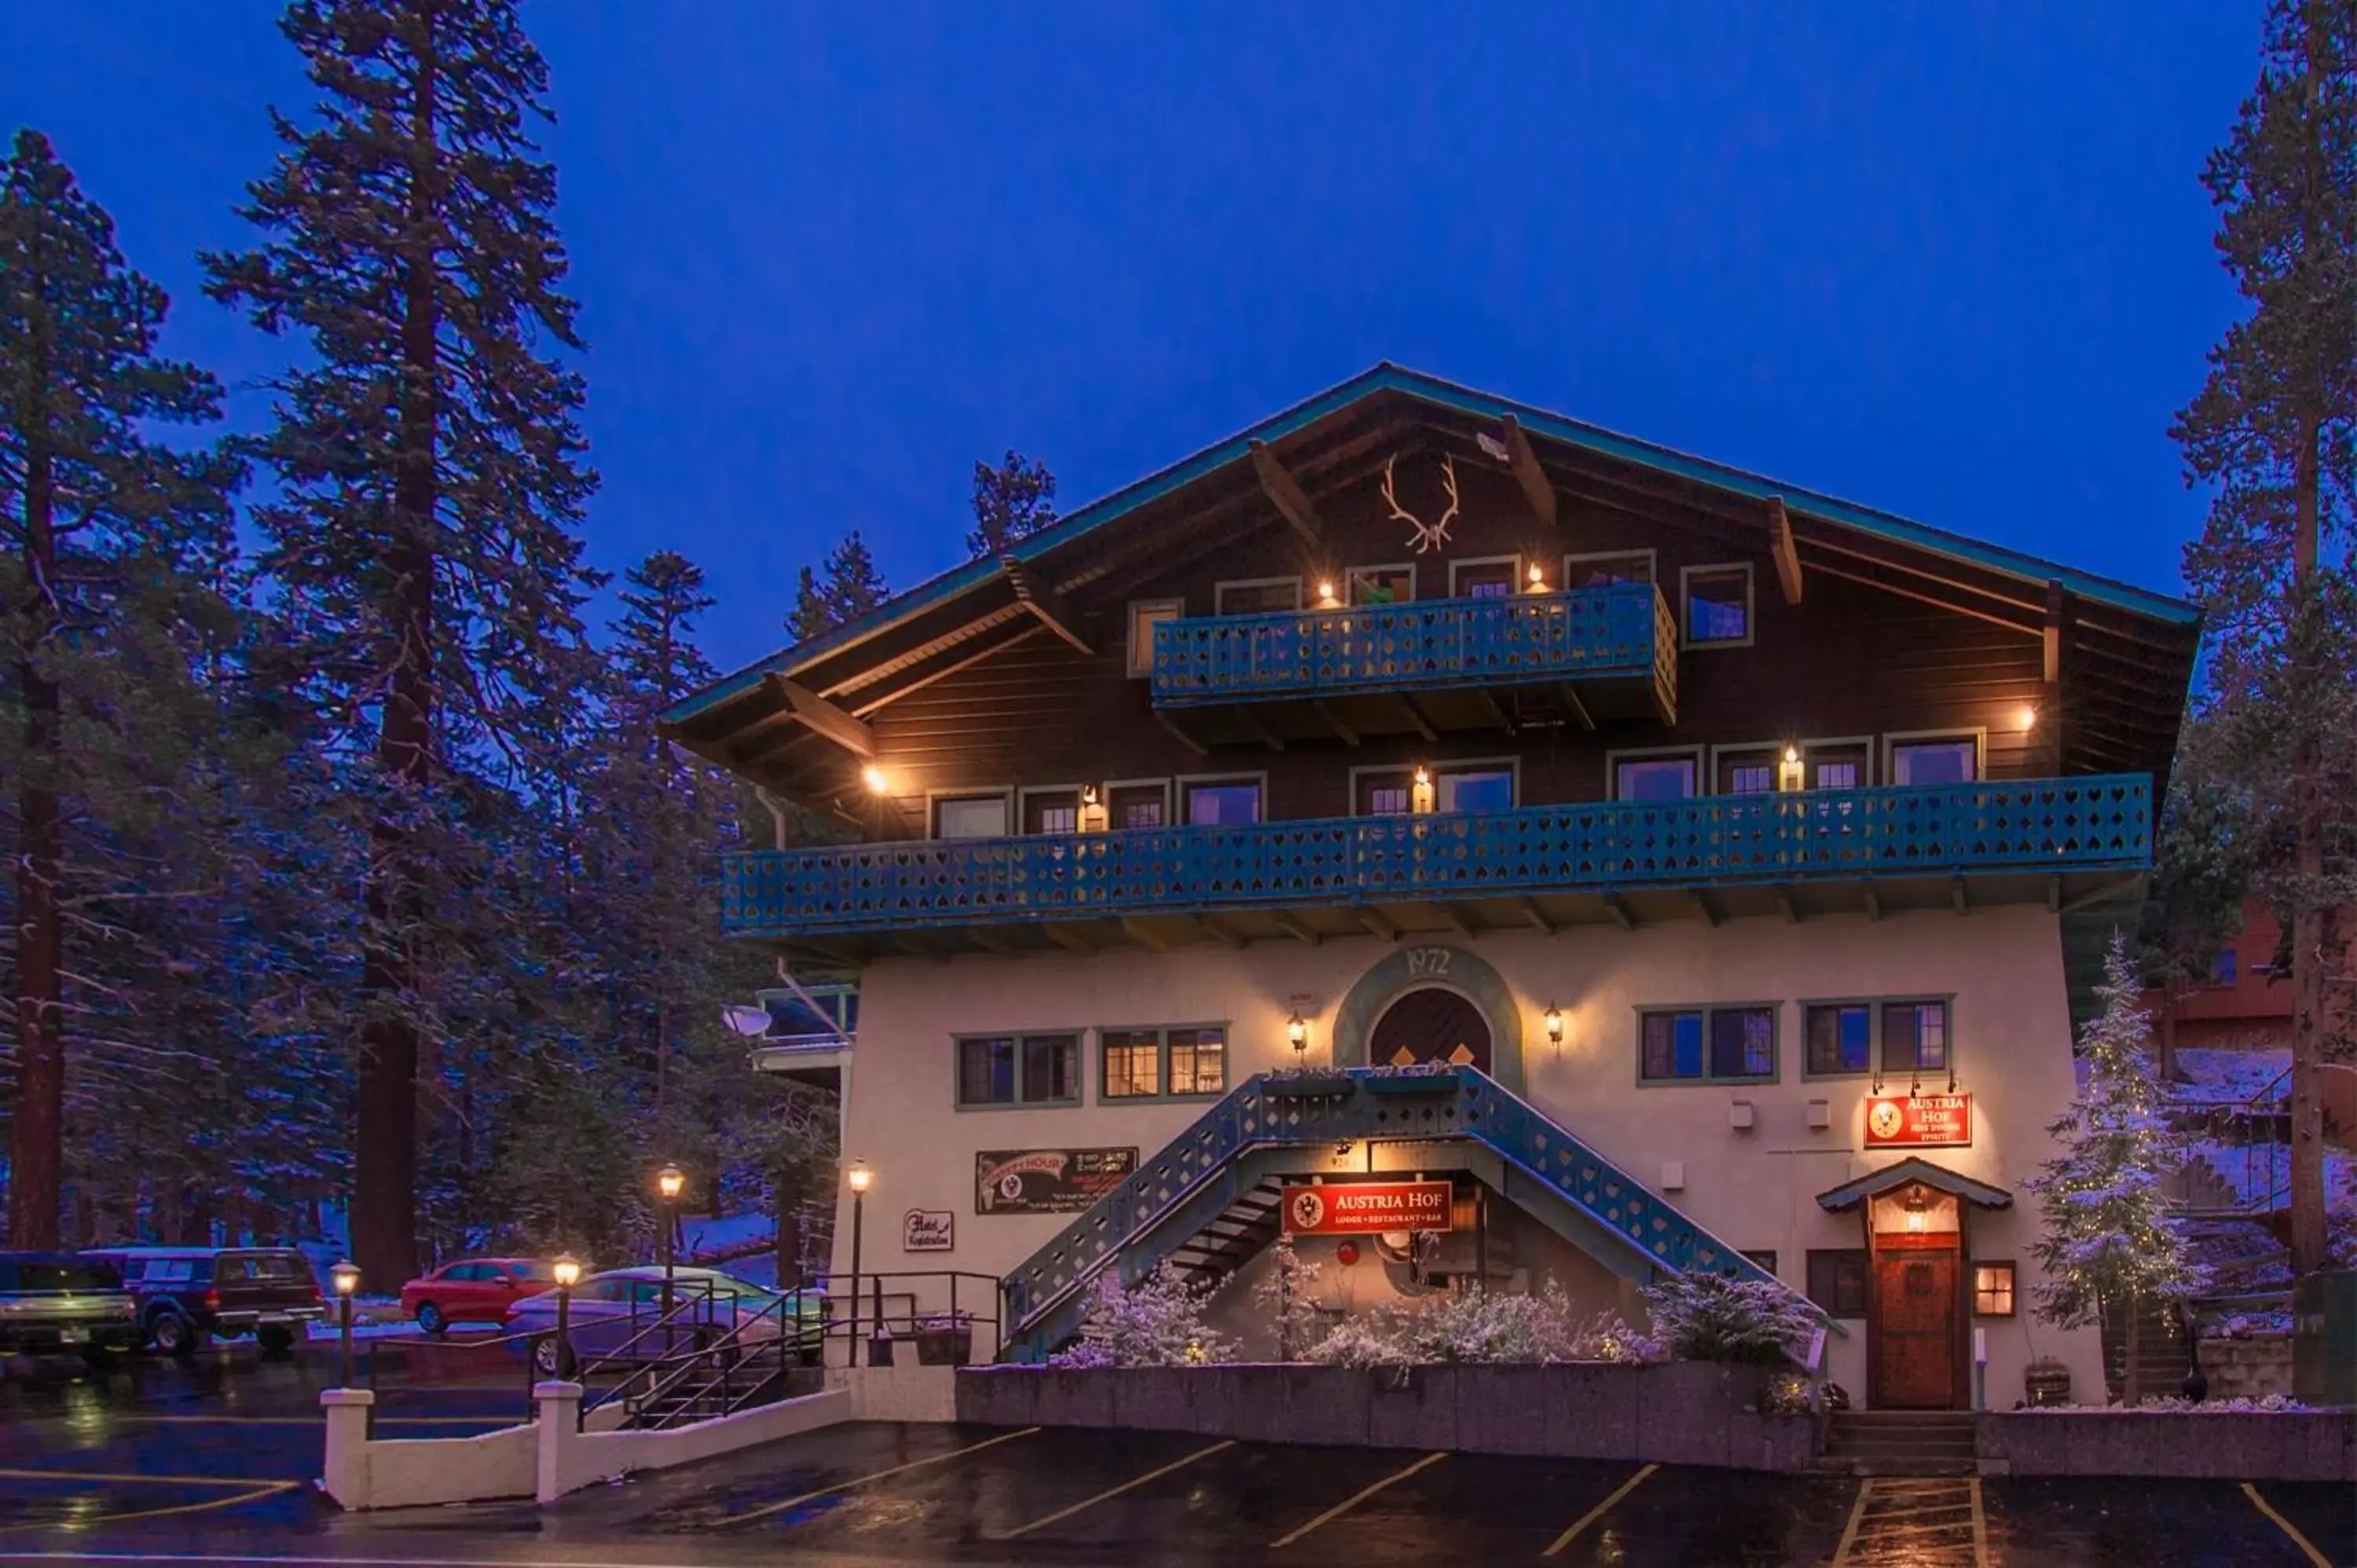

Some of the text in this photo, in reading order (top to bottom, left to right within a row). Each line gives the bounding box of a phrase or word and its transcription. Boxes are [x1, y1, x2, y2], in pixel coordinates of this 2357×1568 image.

[1406, 947, 1451, 974] 1972
[1907, 1097, 1964, 1109] AUSTRIA
[1921, 1110, 1949, 1123] HOF
[1025, 1157, 1060, 1170] HOUR
[1335, 1192, 1443, 1210] AUSTRIA HOF
[907, 1214, 938, 1233] Hotel
[1335, 1213, 1442, 1224] LODGE RESTAURANT BAR
